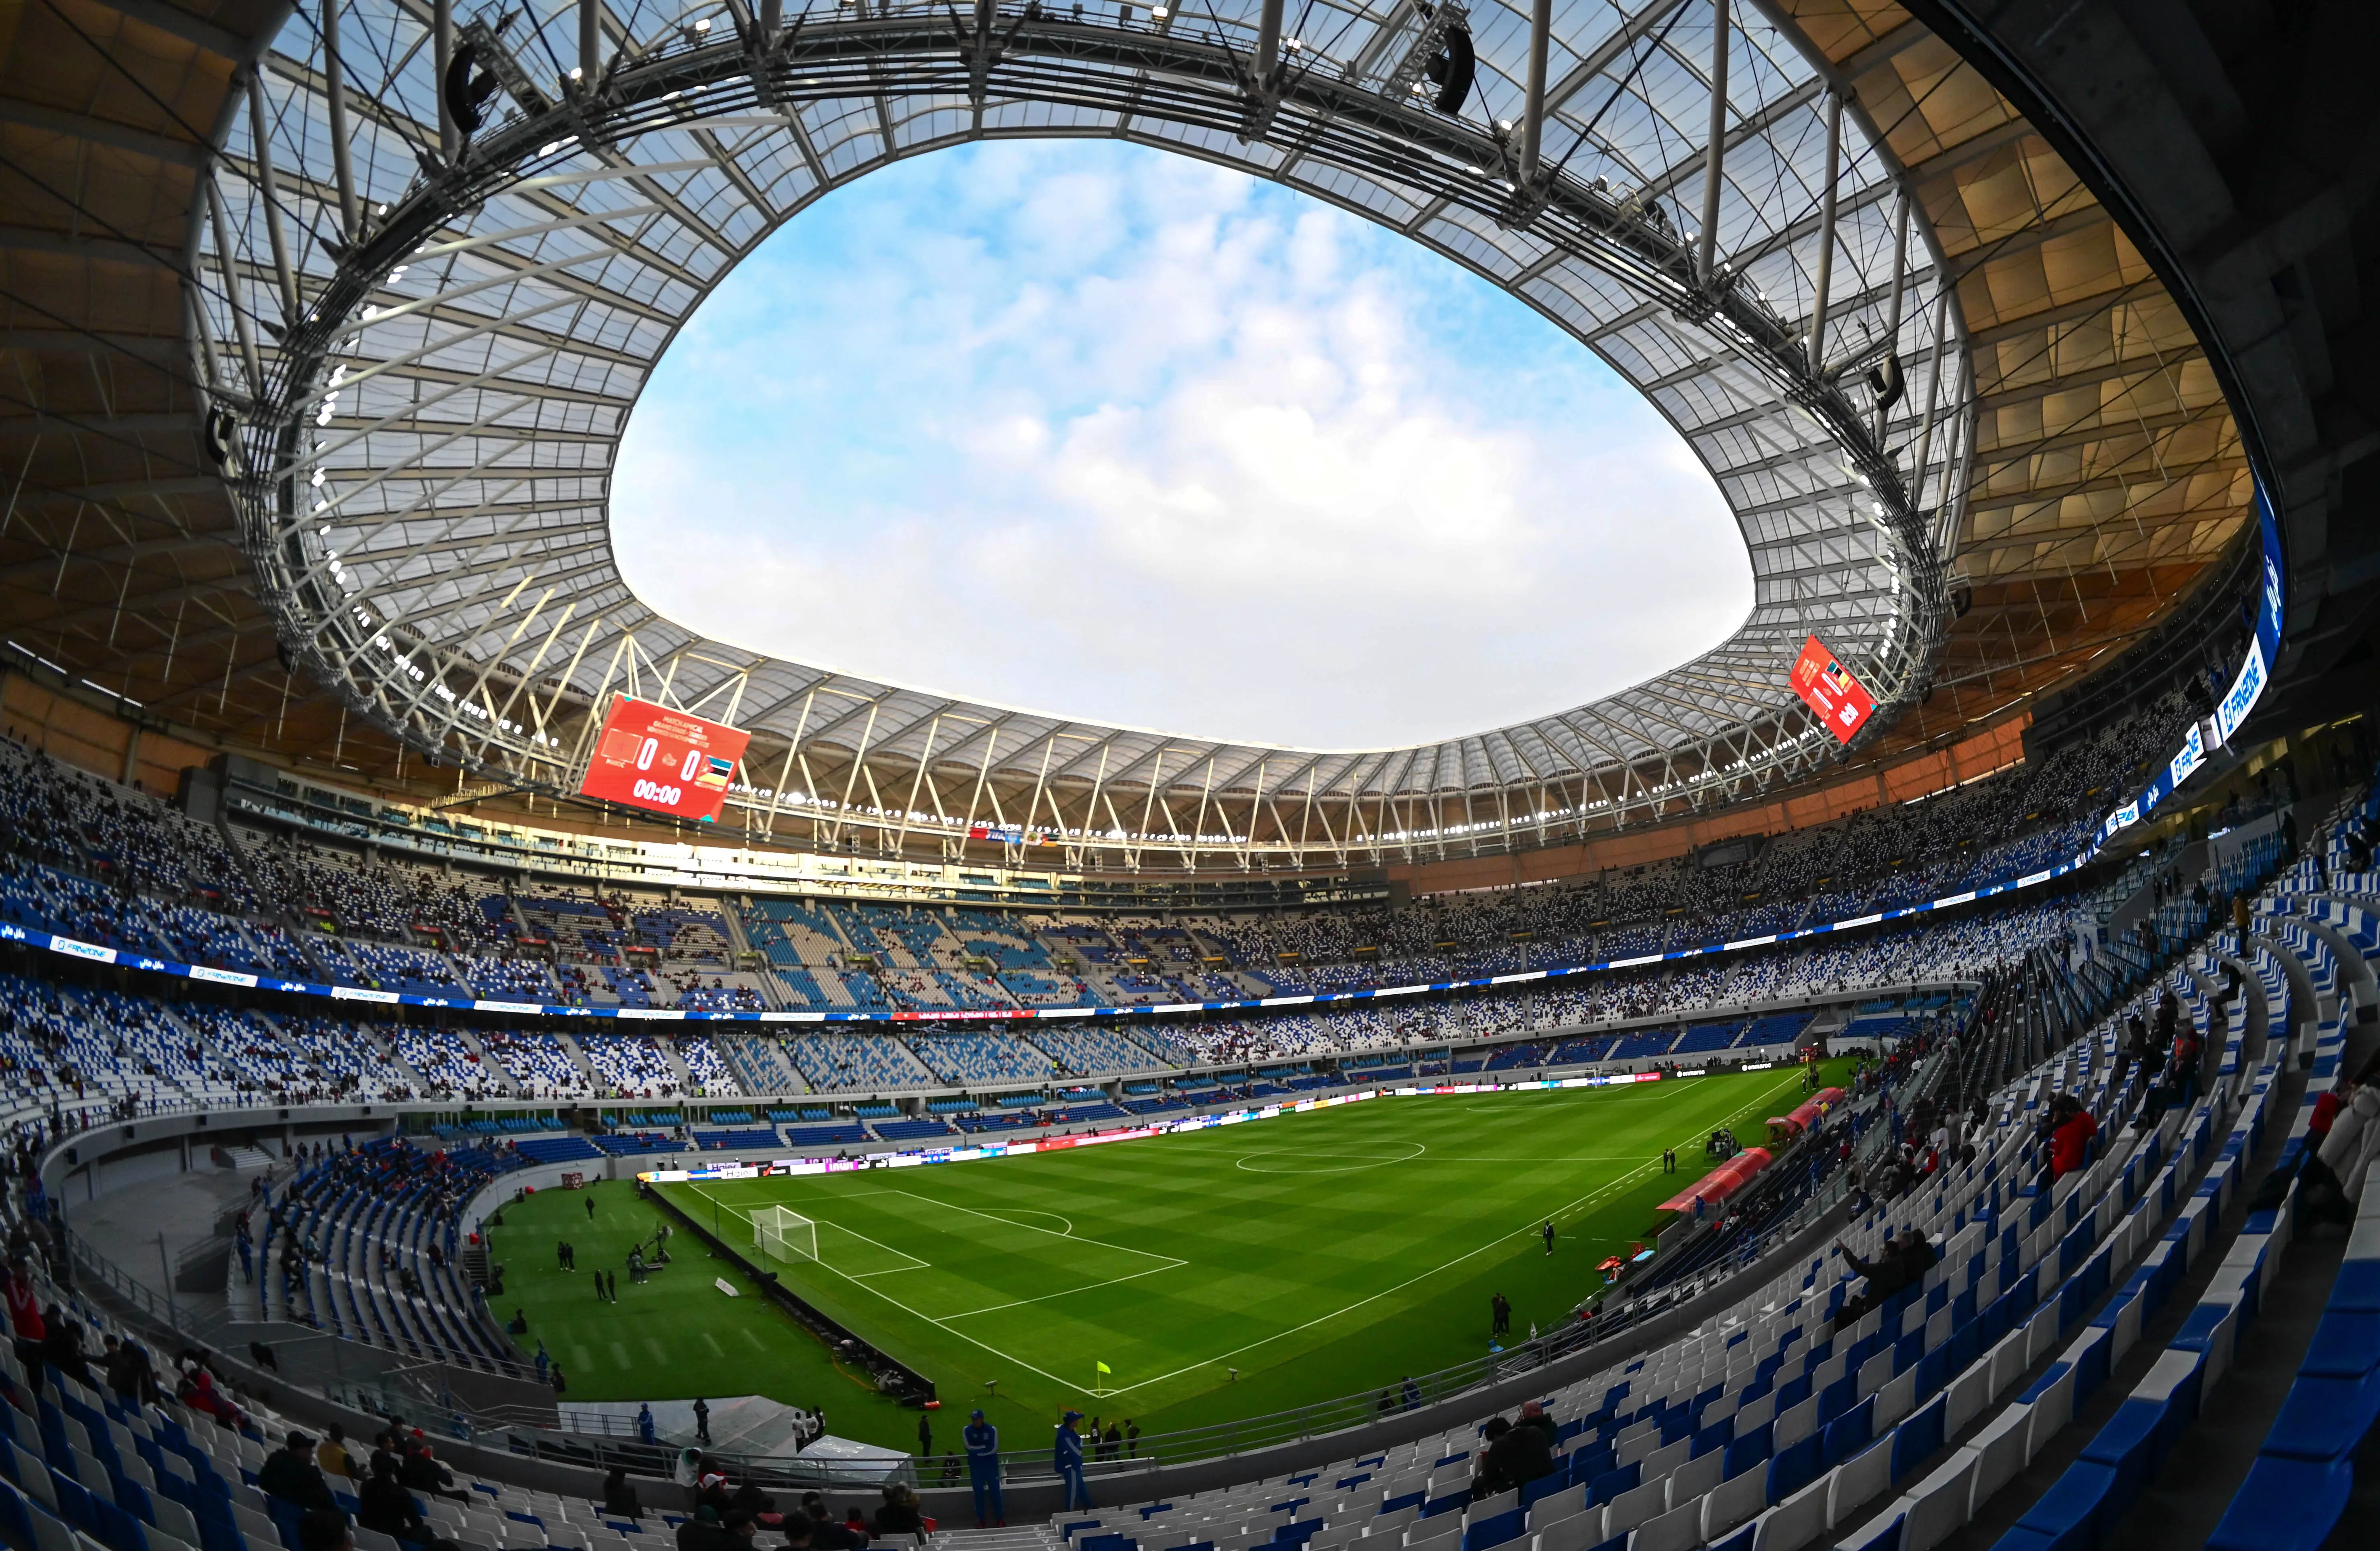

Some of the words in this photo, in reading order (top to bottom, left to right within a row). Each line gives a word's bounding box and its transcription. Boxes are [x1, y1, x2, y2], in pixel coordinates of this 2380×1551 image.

[1813, 687, 1833, 710] 0
[1821, 673, 1843, 696] 0
[2231, 655, 2260, 721] FANZONE
[637, 738, 658, 770] 0
[681, 750, 701, 781] 0
[633, 779, 681, 805] 00:00
